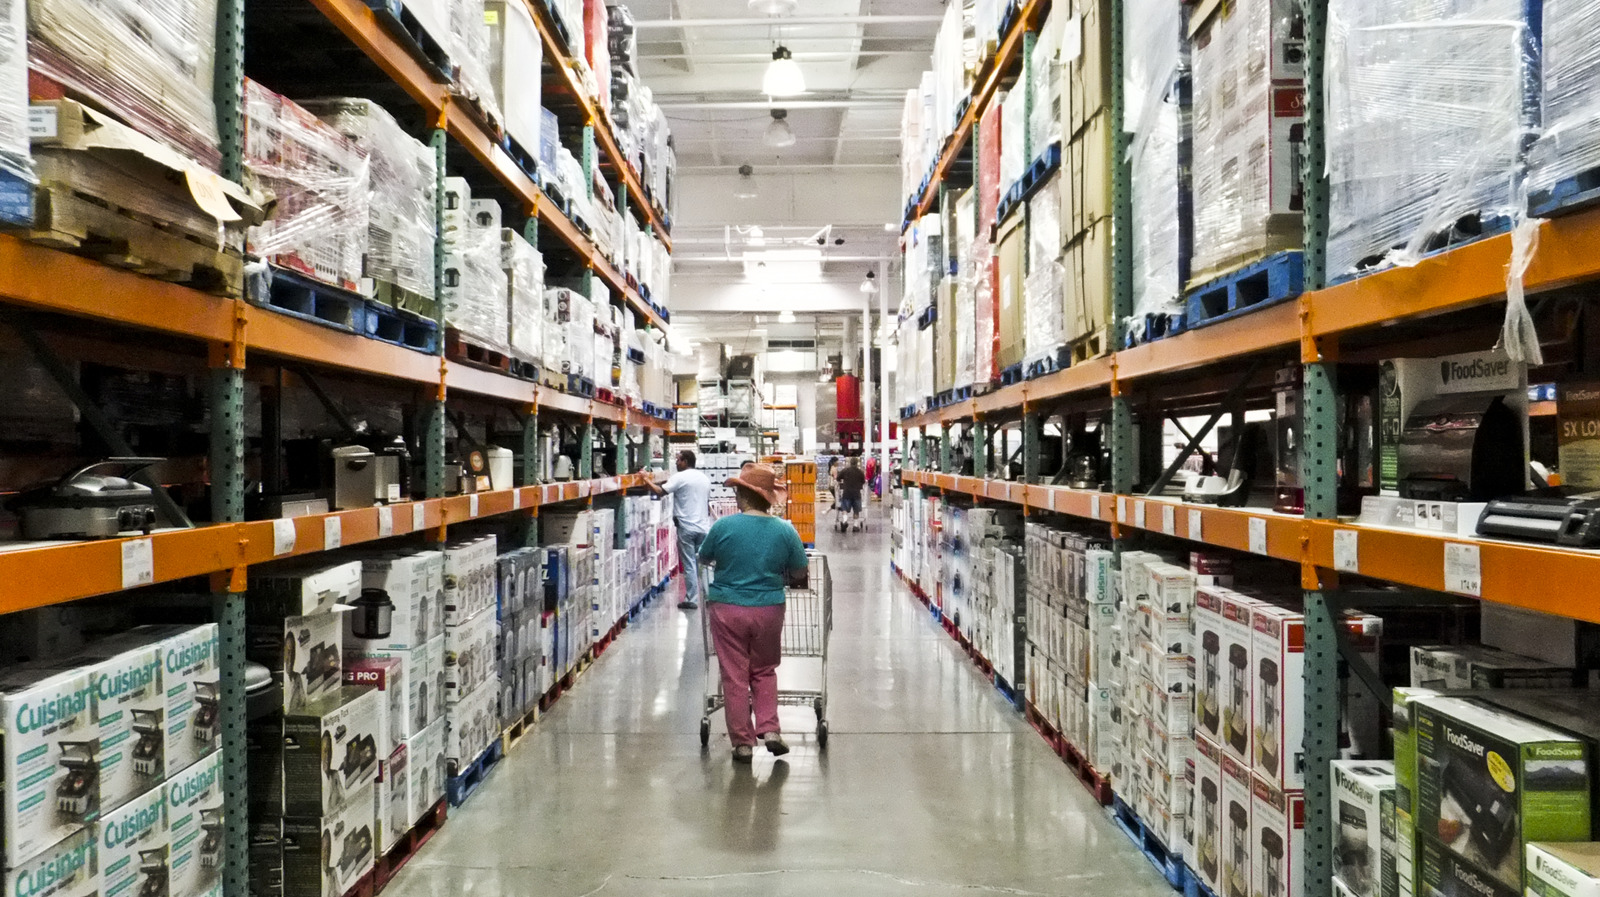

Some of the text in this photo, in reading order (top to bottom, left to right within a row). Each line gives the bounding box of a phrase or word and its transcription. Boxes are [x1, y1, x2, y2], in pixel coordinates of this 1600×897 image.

[1451, 358, 1509, 380] FoodSaver
[1097, 556, 1106, 601] Cuisinart
[166, 637, 219, 674] Cuisinart
[1420, 652, 1451, 673] FoodSaver
[98, 659, 162, 701] Cuisinart
[357, 672, 379, 681] PRO
[16, 682, 99, 734] Cuisinart
[1446, 728, 1485, 757] FoodSaver
[1535, 747, 1582, 757] FoodSaver
[169, 760, 223, 807] Cuisinart
[1340, 771, 1374, 805] FoodSaver
[104, 794, 168, 849] Cuisinart
[16, 836, 98, 897] Cuisinart
[1454, 863, 1495, 897] FoodSaver
[1541, 860, 1579, 890] FoodSaver
